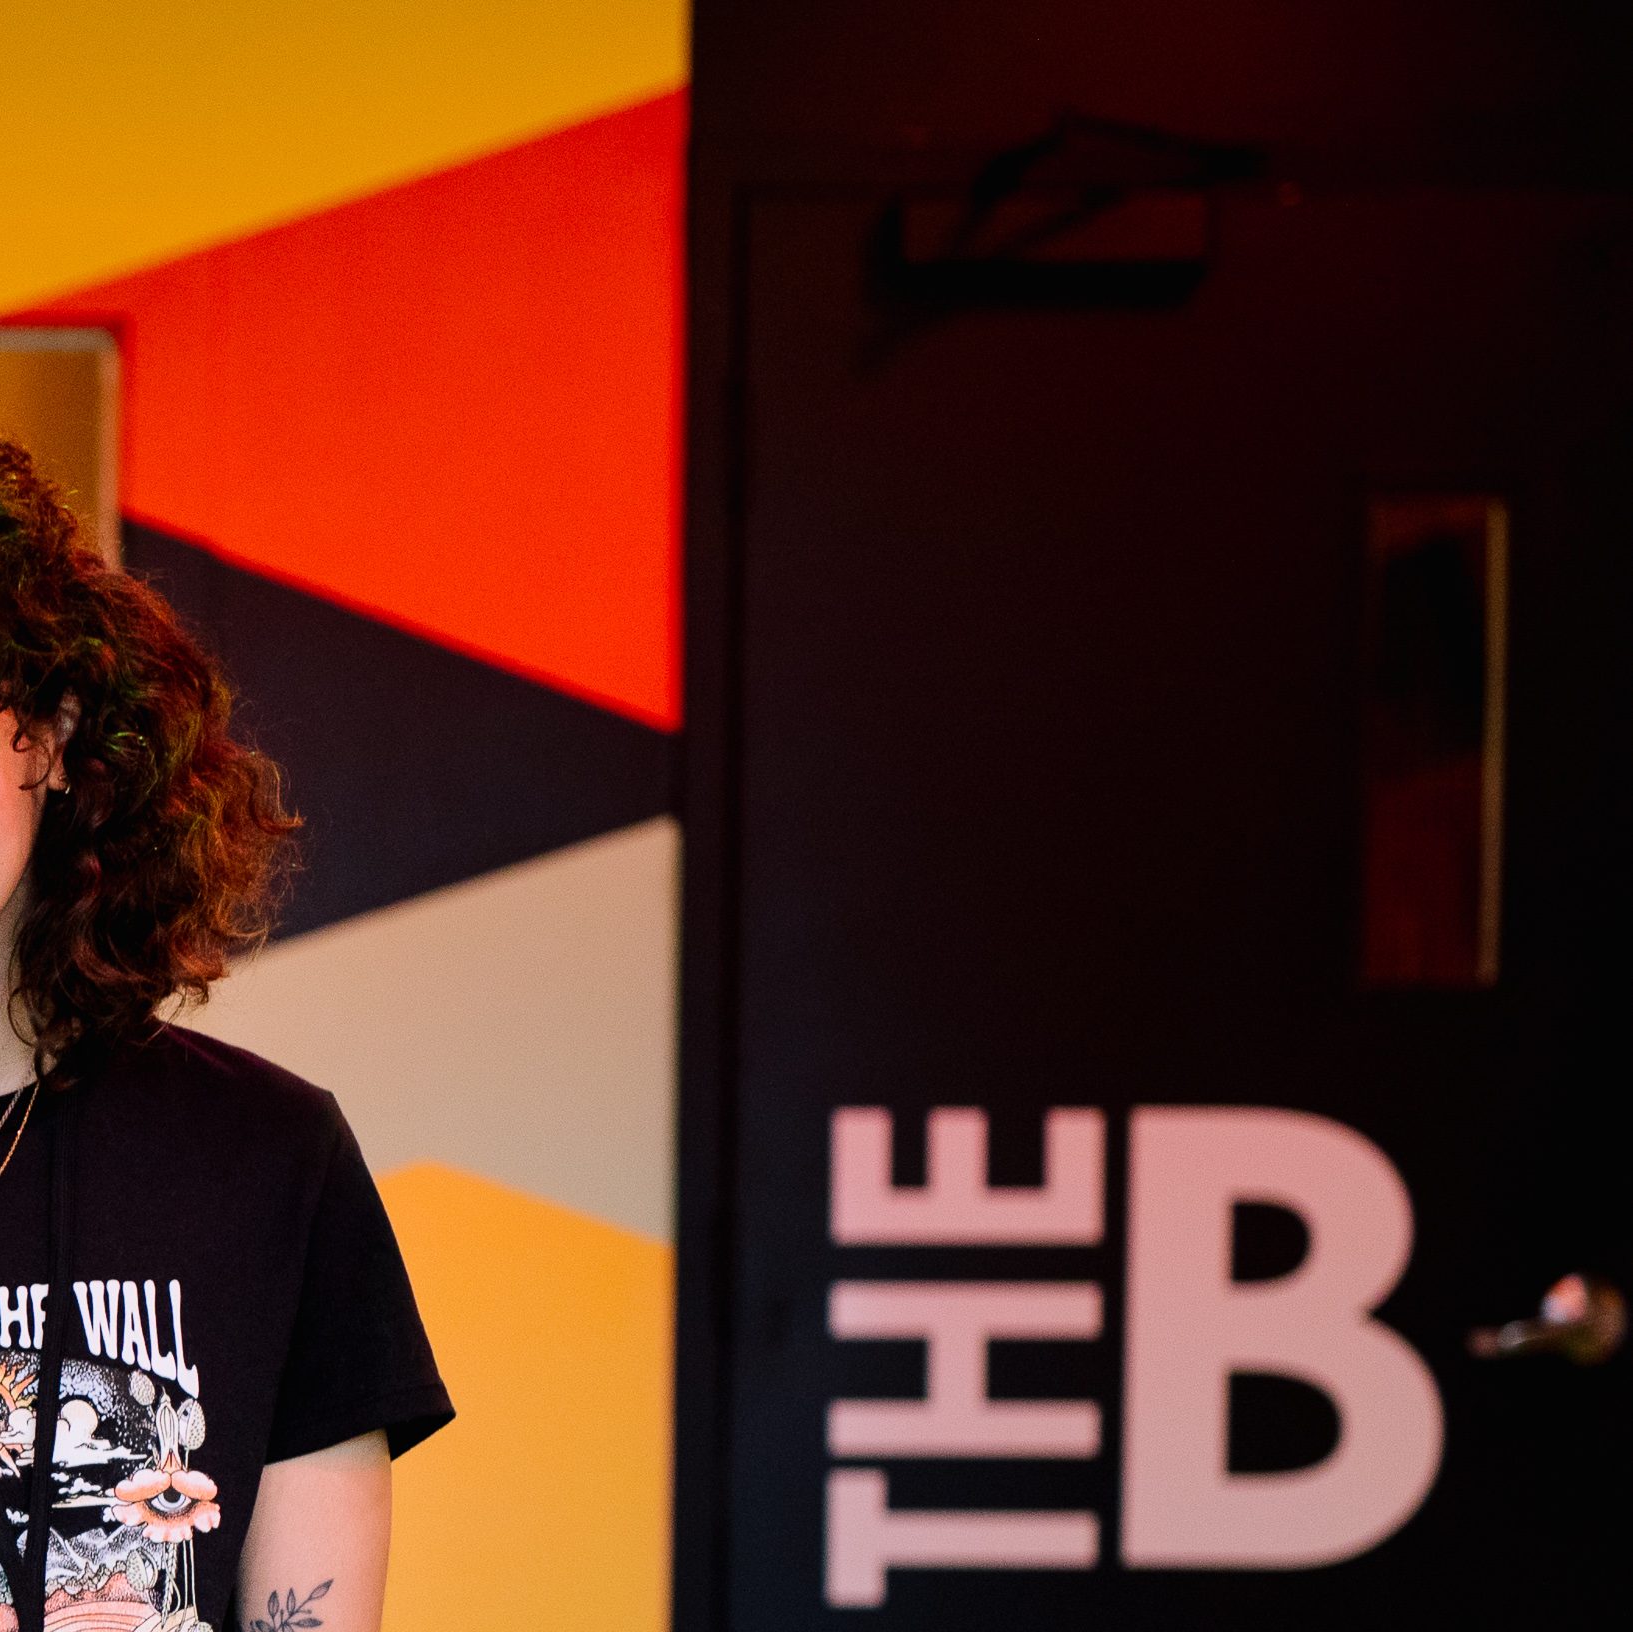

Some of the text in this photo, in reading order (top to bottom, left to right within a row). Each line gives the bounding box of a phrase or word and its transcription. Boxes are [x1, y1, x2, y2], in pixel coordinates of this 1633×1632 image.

[73, 1279, 200, 1399] WALL
[825, 1106, 1446, 1607] THE B
